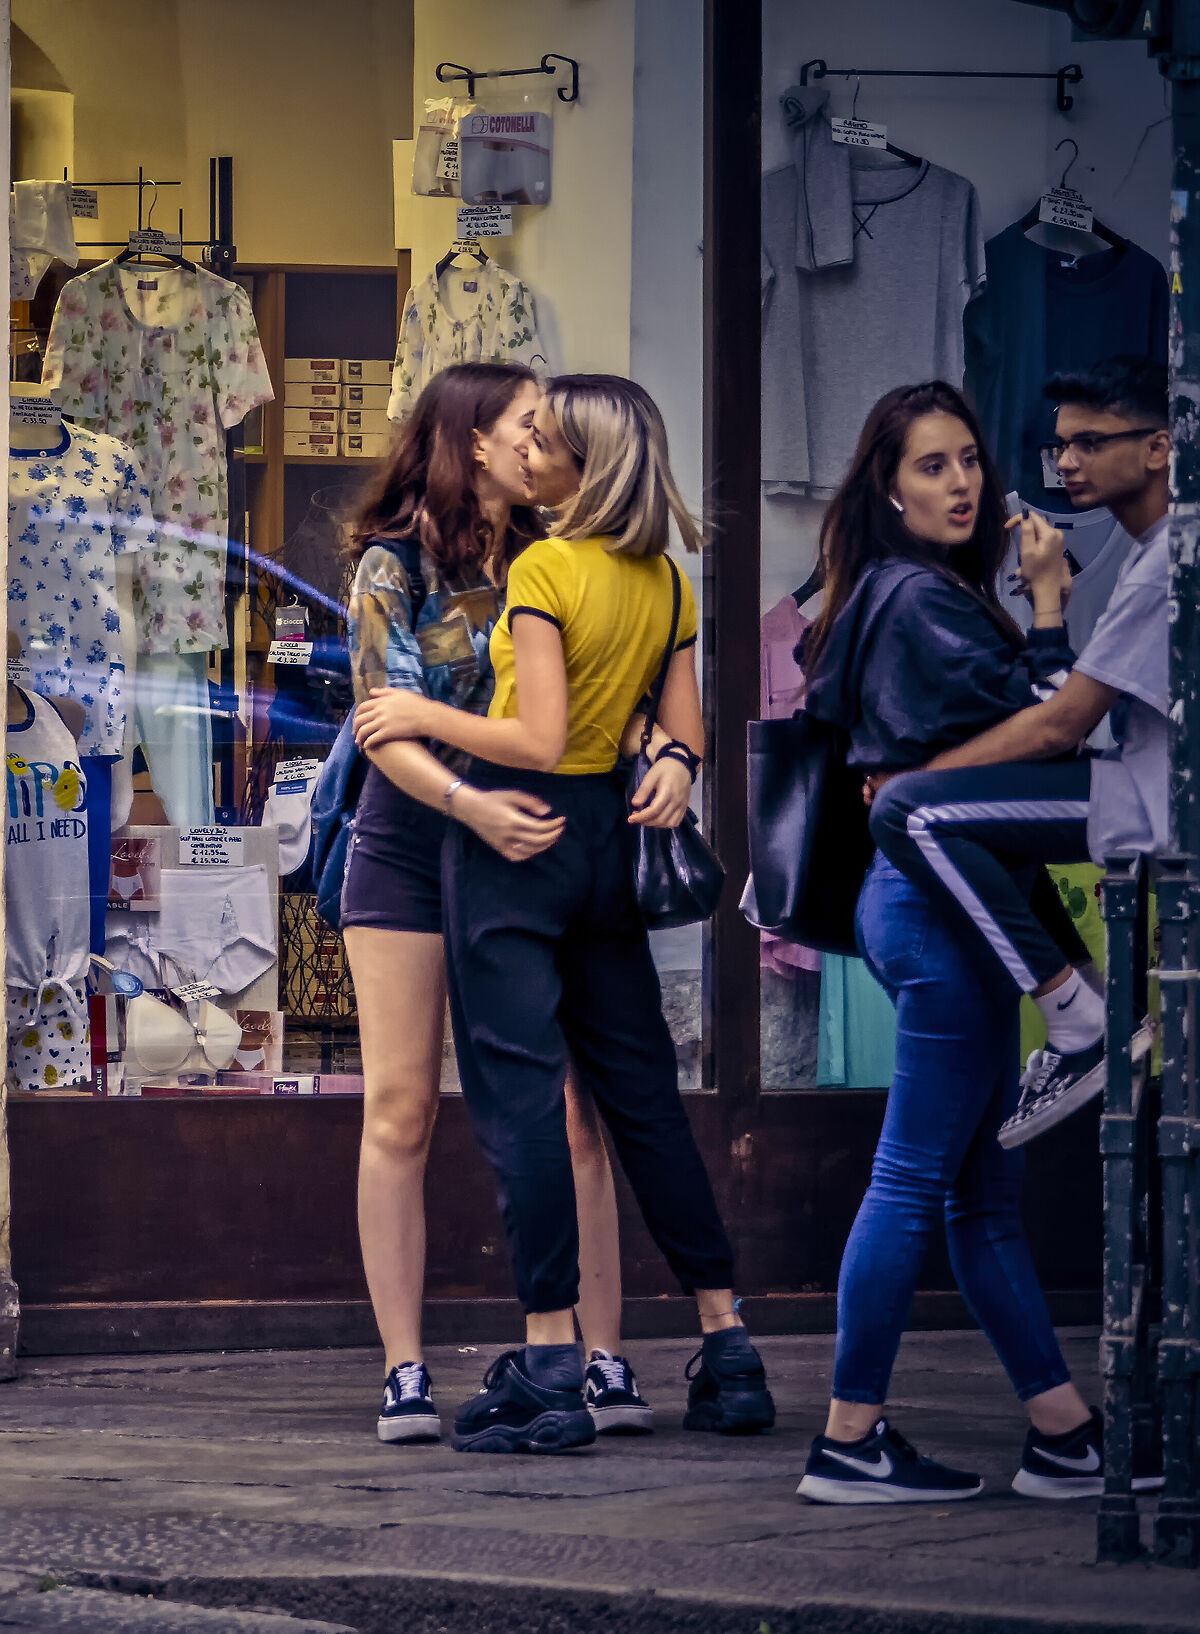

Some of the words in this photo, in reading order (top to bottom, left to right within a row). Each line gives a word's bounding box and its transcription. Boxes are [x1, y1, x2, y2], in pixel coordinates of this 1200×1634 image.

[490, 116, 535, 133] COTONELLA
[8, 823, 30, 844] ALL
[37, 821, 45, 840] I
[51, 819, 86, 839] NEED
